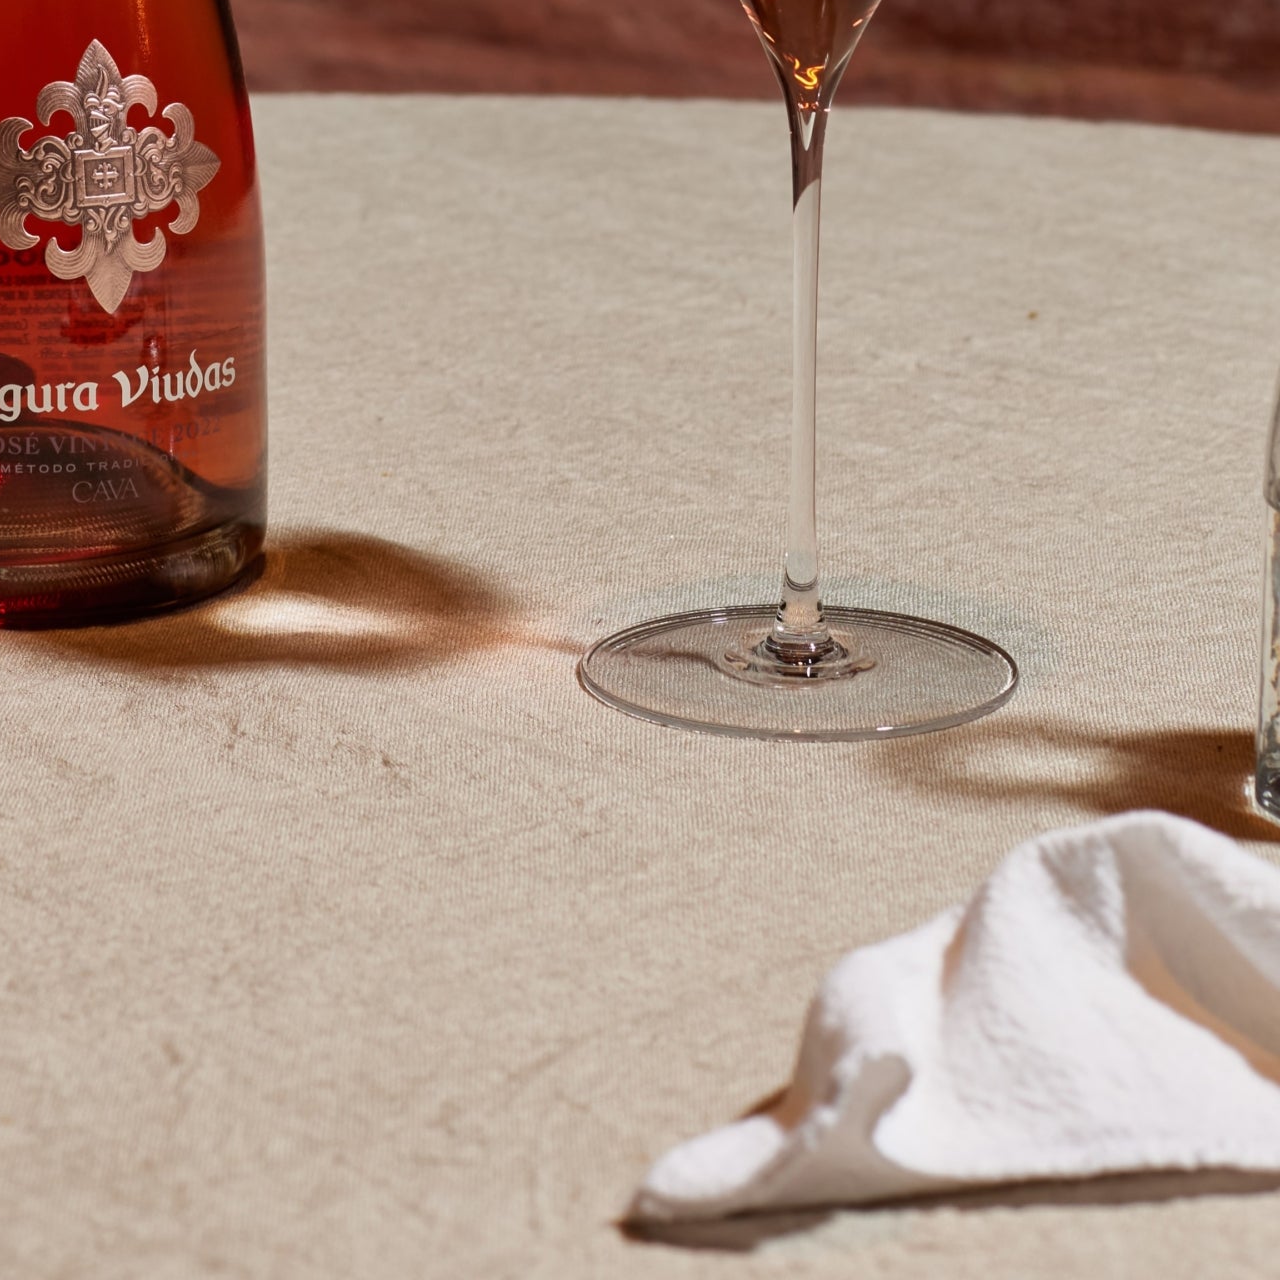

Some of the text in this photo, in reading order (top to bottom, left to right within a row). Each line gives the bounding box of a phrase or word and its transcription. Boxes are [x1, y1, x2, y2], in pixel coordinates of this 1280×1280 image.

[112, 348, 237, 409] Viudas
[173, 416, 221, 444] 2022
[0, 462, 77, 474] MÉTODO
[72, 477, 140, 503] CAVA
